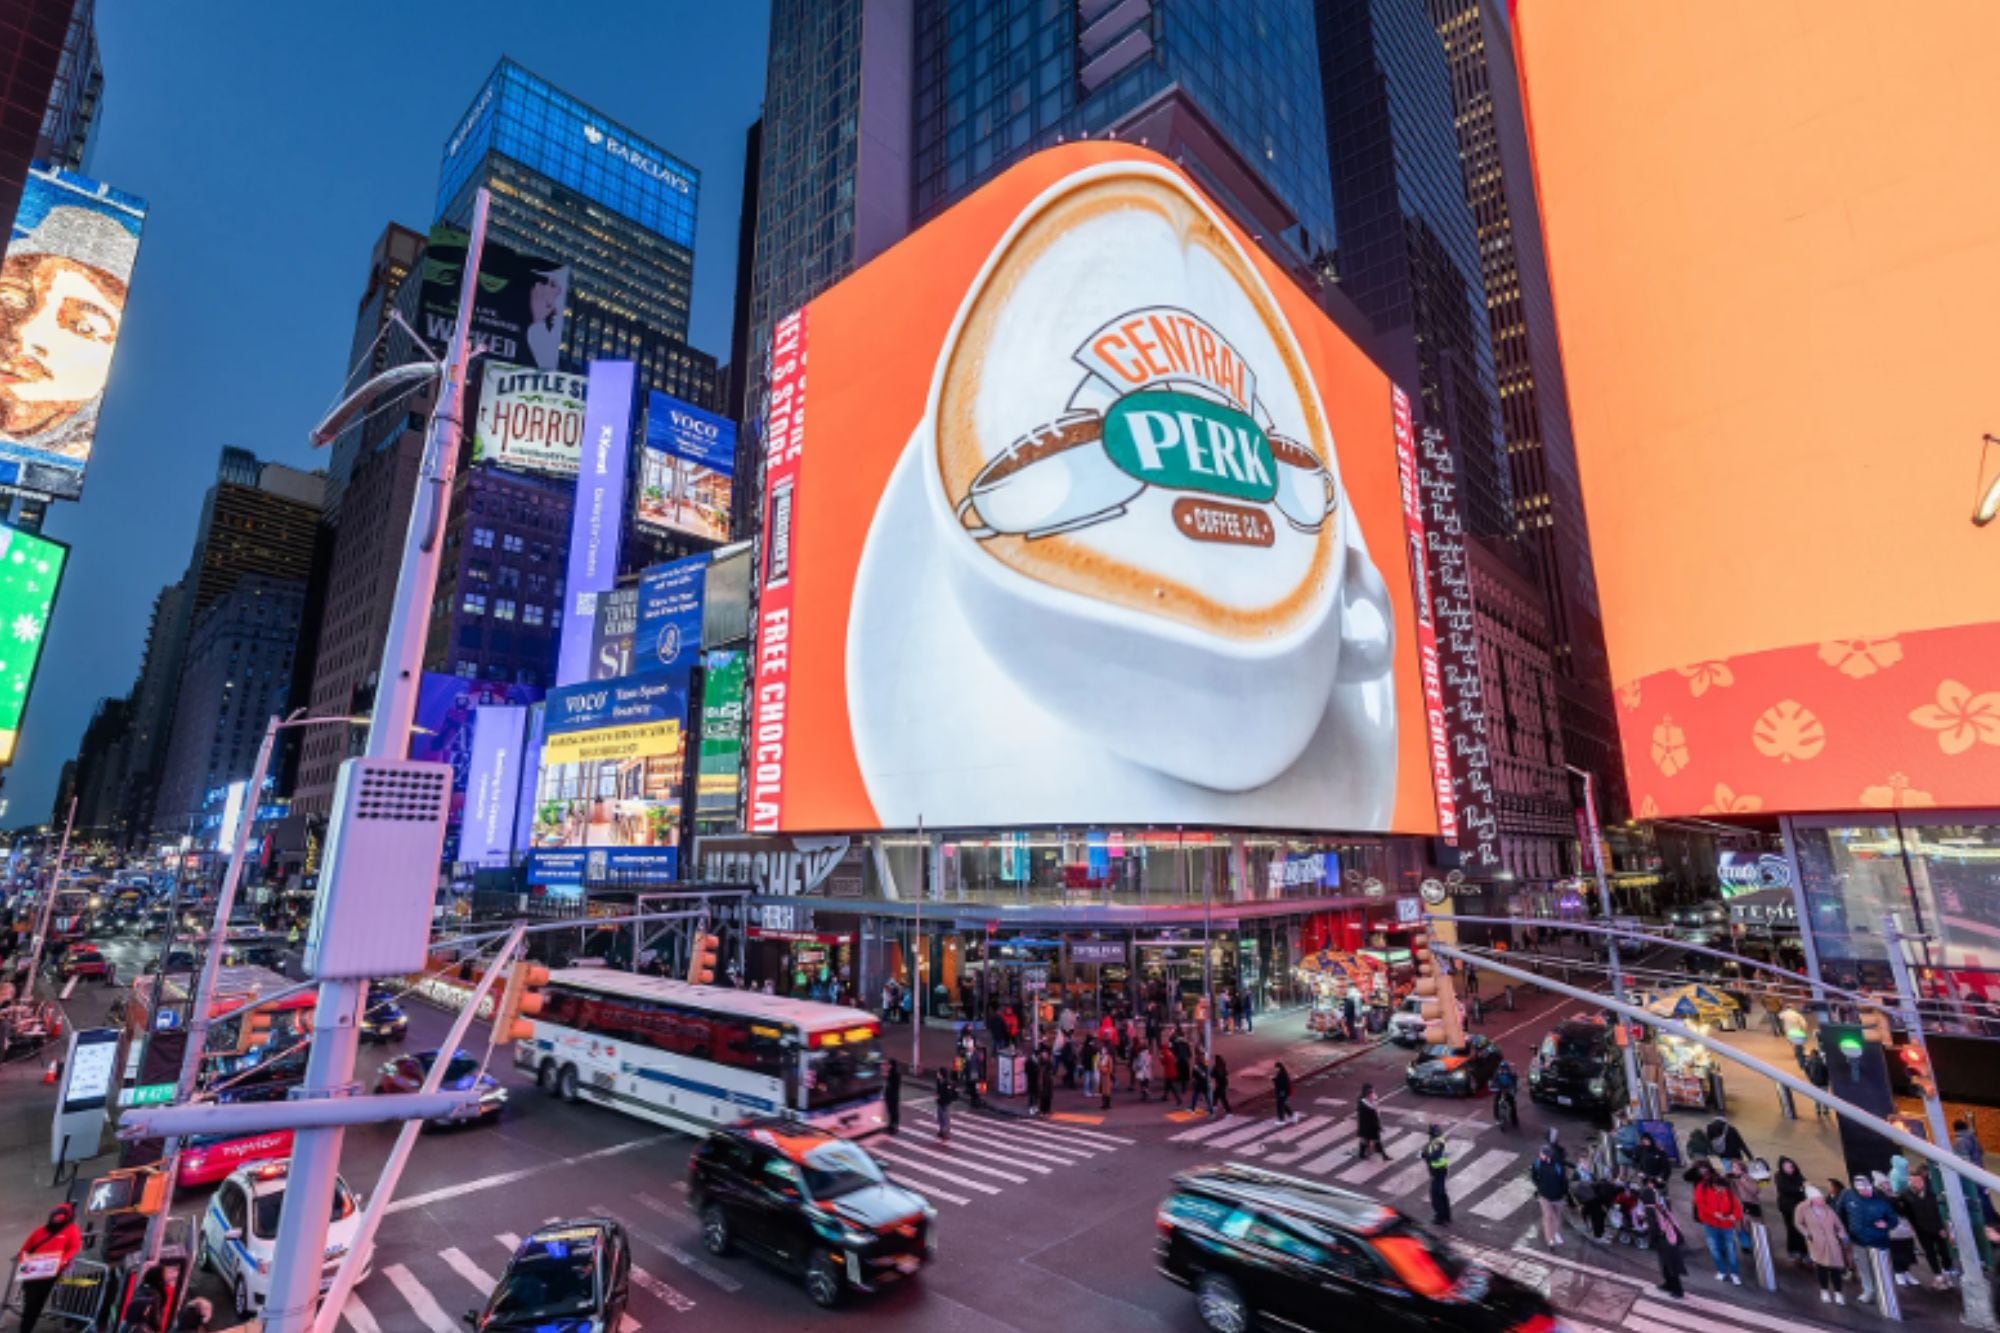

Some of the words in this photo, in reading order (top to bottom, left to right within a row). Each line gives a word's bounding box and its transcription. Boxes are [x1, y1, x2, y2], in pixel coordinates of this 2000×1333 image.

[607, 137, 688, 193] BARCLAYS
[426, 313, 517, 359] WKED
[1092, 315, 1248, 406] CENTRAL
[497, 375, 565, 396] LITTLE
[490, 400, 585, 453] HORRO
[767, 383, 794, 469] STORE
[1123, 410, 1272, 487] PERK
[1193, 508, 1243, 537] COFFEE
[762, 607, 790, 677] FREE
[753, 682, 787, 832] CHOCOLAT
